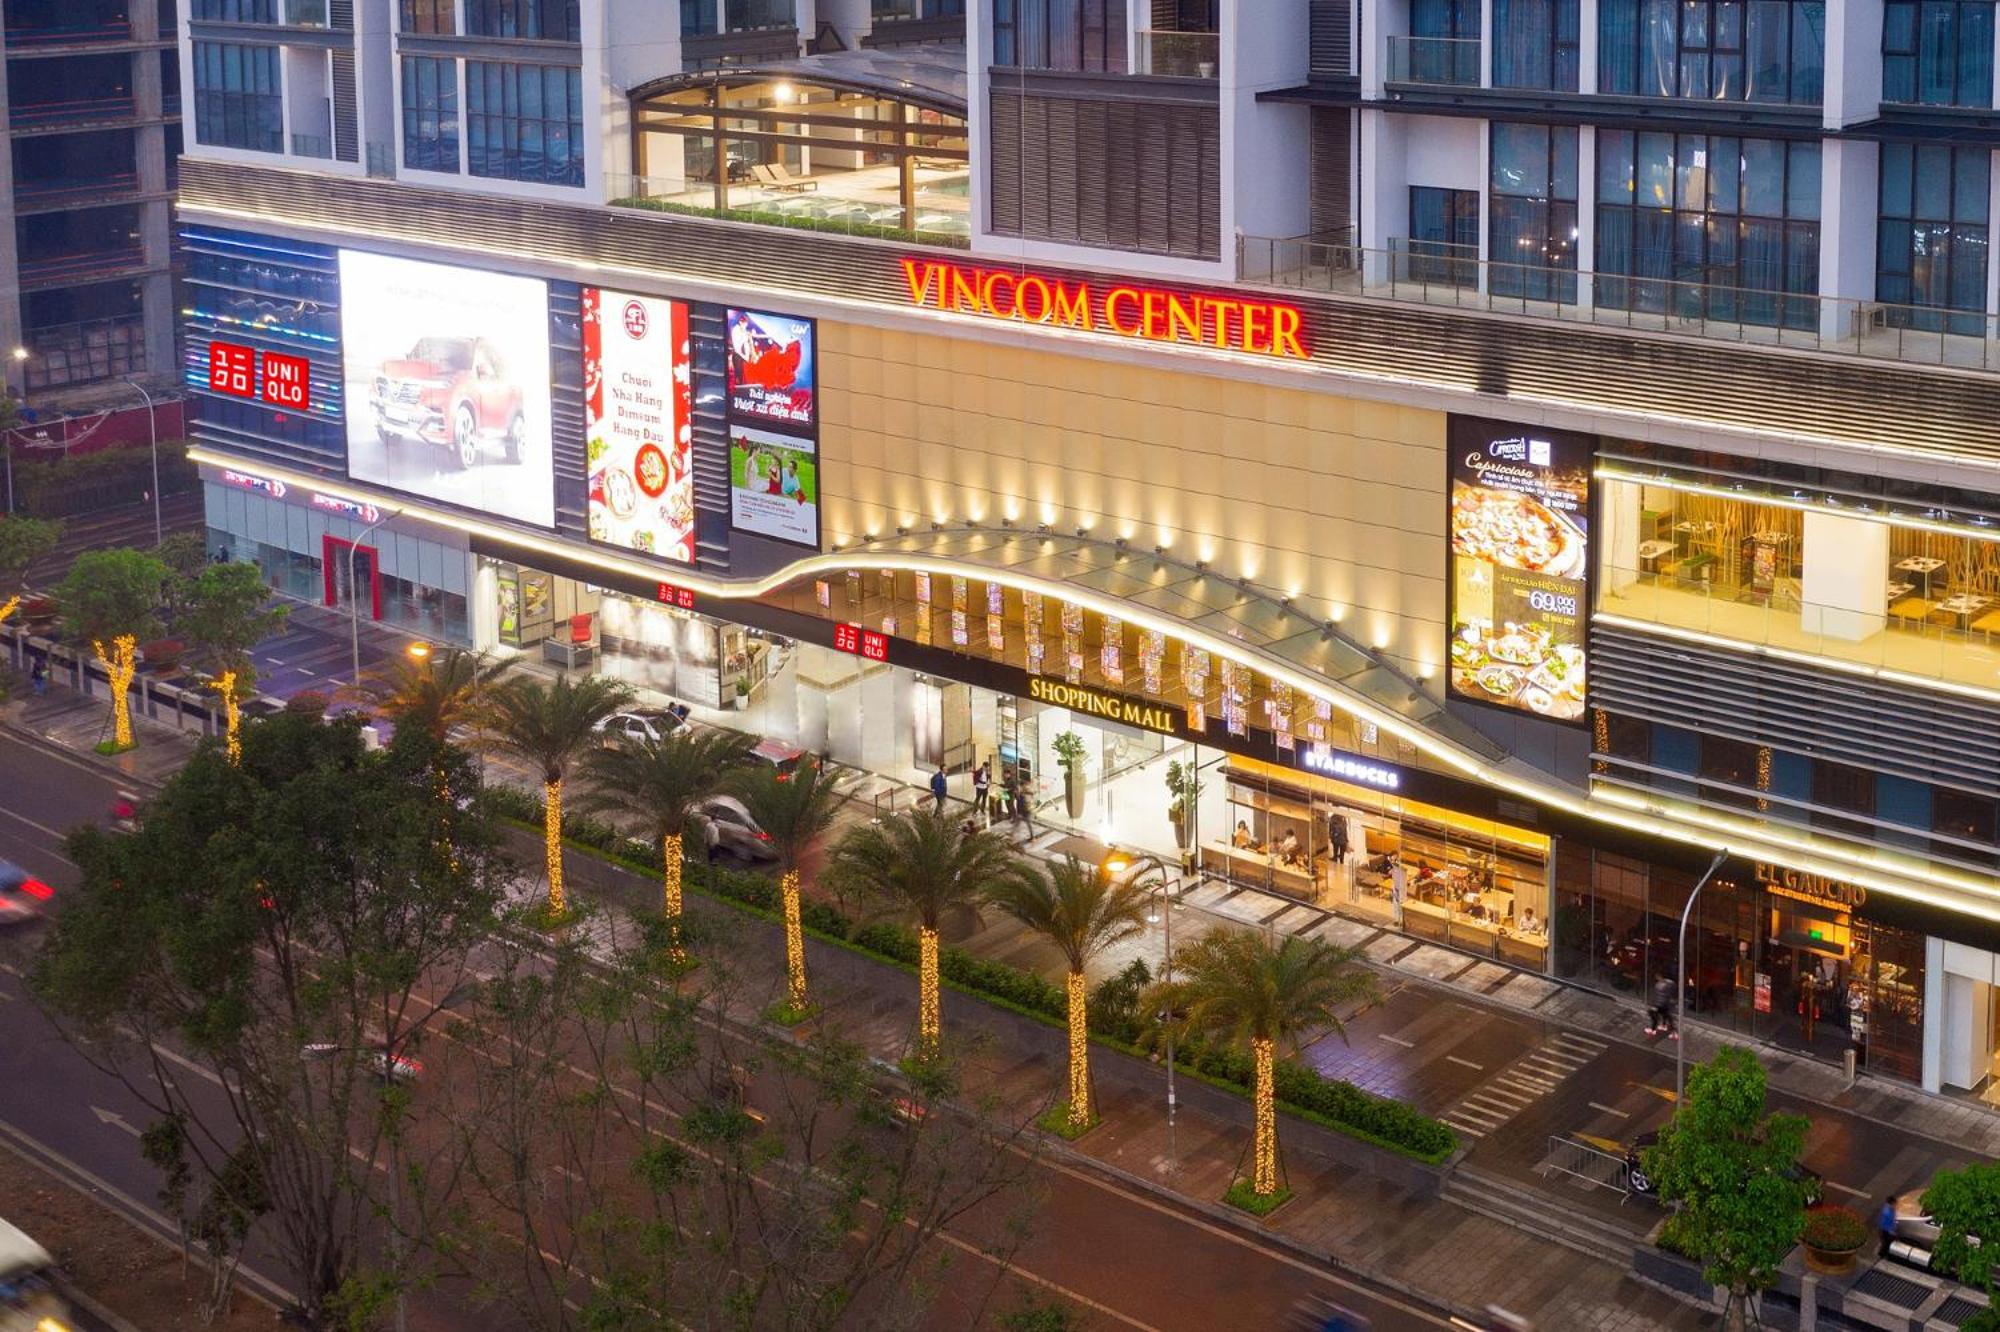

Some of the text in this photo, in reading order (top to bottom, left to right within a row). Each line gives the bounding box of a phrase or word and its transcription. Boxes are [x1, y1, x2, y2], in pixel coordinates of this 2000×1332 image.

[902, 260, 1311, 359] VINCOM CENTER
[215, 349, 246, 371] ユニ
[267, 360, 300, 382] UNI
[214, 369, 247, 391] クロ
[267, 380, 302, 402] QLO
[864, 645, 884, 658] QLO
[865, 634, 882, 648] UNI
[1030, 678, 1175, 733] SHOPPING MALL
[1305, 750, 1398, 788] STARBUCKS
[1783, 866, 1867, 907] GAUCHO
